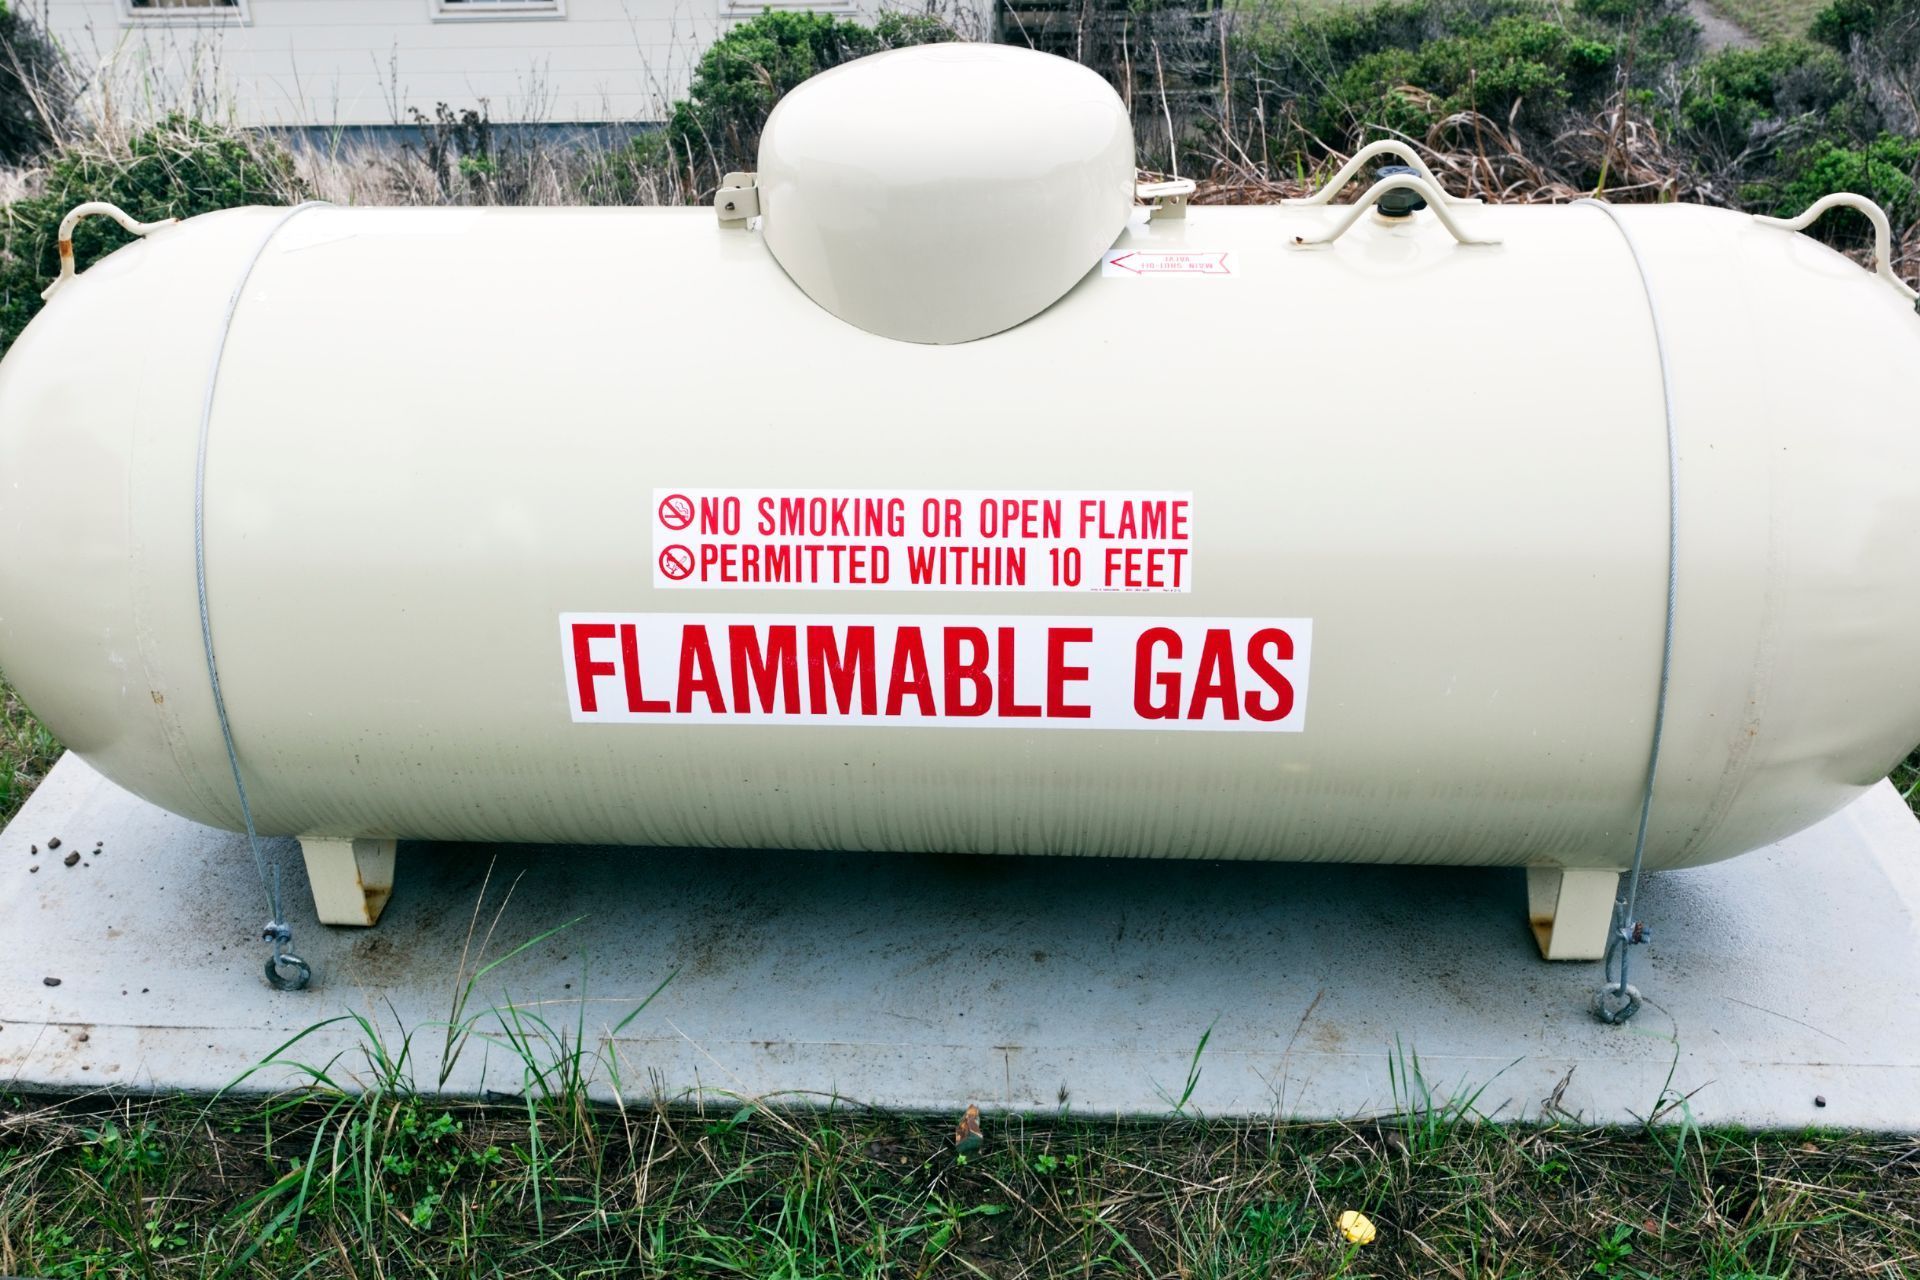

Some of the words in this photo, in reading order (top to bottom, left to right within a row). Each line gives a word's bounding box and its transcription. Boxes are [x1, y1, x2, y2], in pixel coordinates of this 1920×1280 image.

[700, 496, 741, 535] NO
[757, 496, 906, 538] SMOKING
[921, 498, 963, 538] OR
[979, 499, 1062, 539] OPEN
[1079, 500, 1189, 541] FLAME
[700, 544, 890, 585] PERMITTED
[906, 546, 1027, 587] WITHIN
[1050, 547, 1082, 588] 10
[1104, 548, 1189, 588] FEET
[571, 623, 1094, 719] FLAMMABLE
[1133, 626, 1295, 723] GAS
